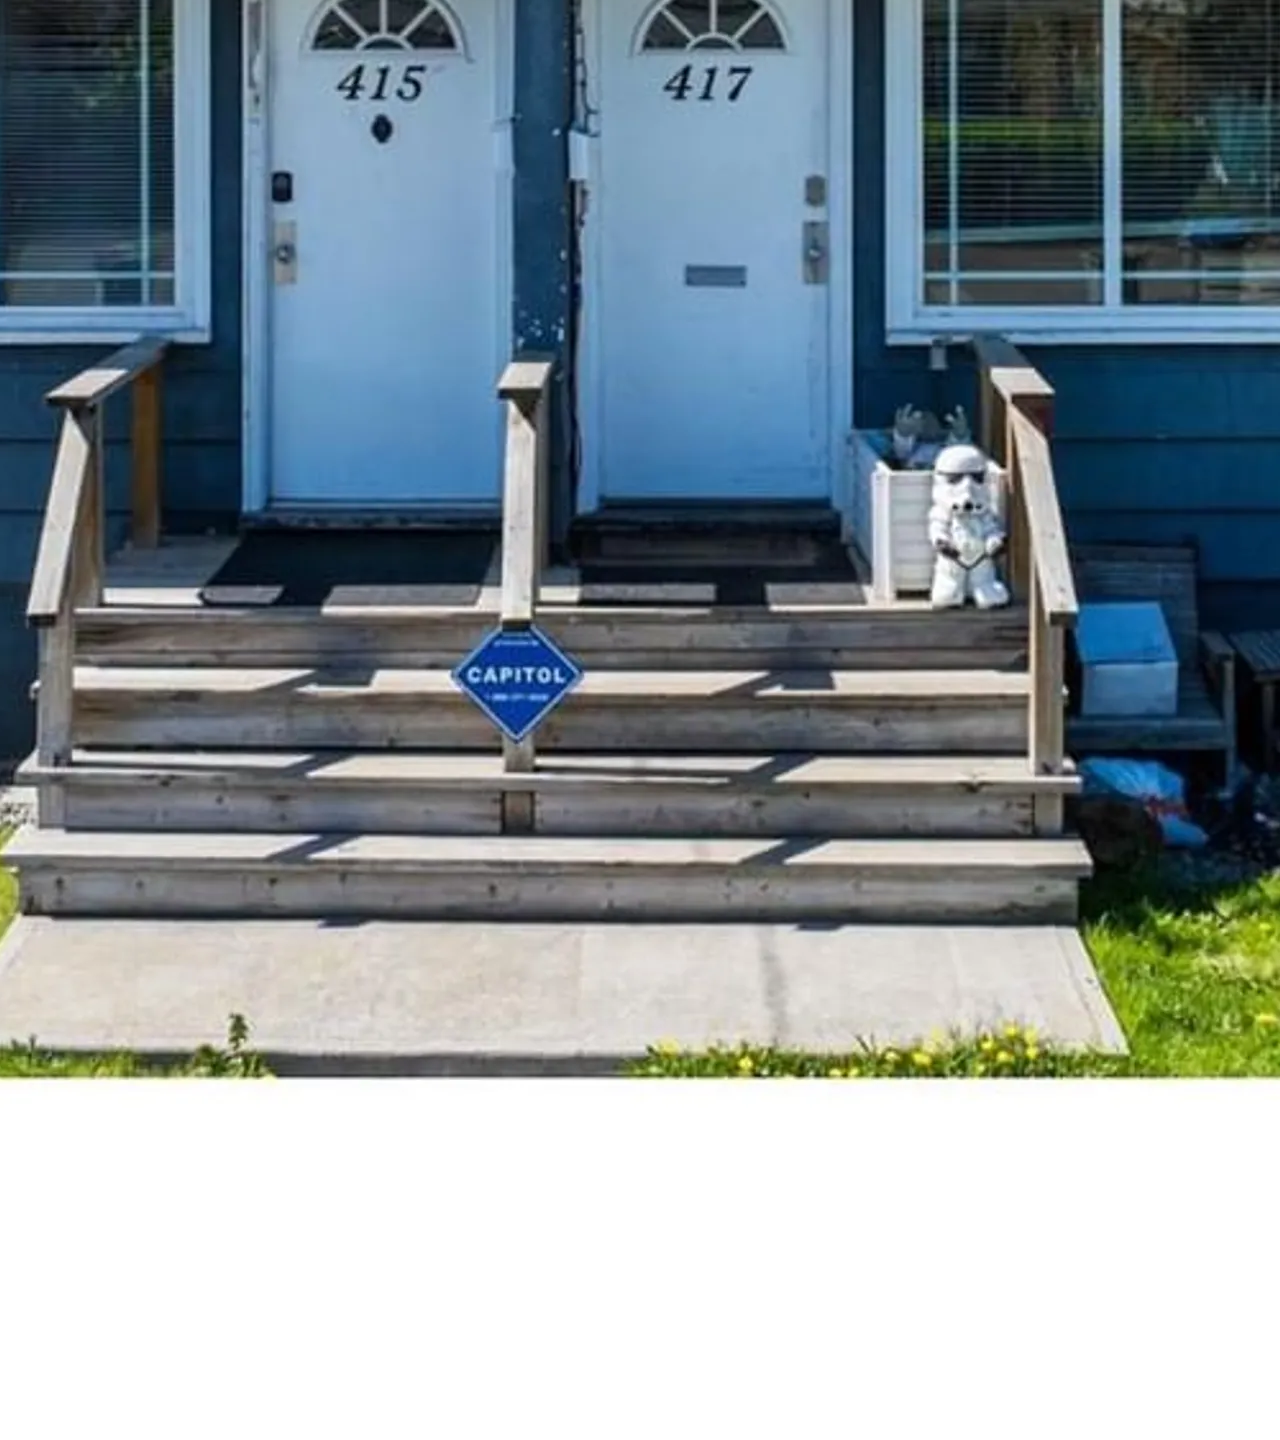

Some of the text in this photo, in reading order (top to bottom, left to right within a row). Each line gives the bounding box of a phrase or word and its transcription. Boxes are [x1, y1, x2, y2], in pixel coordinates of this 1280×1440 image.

[336, 63, 428, 102] 415
[662, 63, 754, 102] 417
[466, 665, 567, 685] CAPITOL
